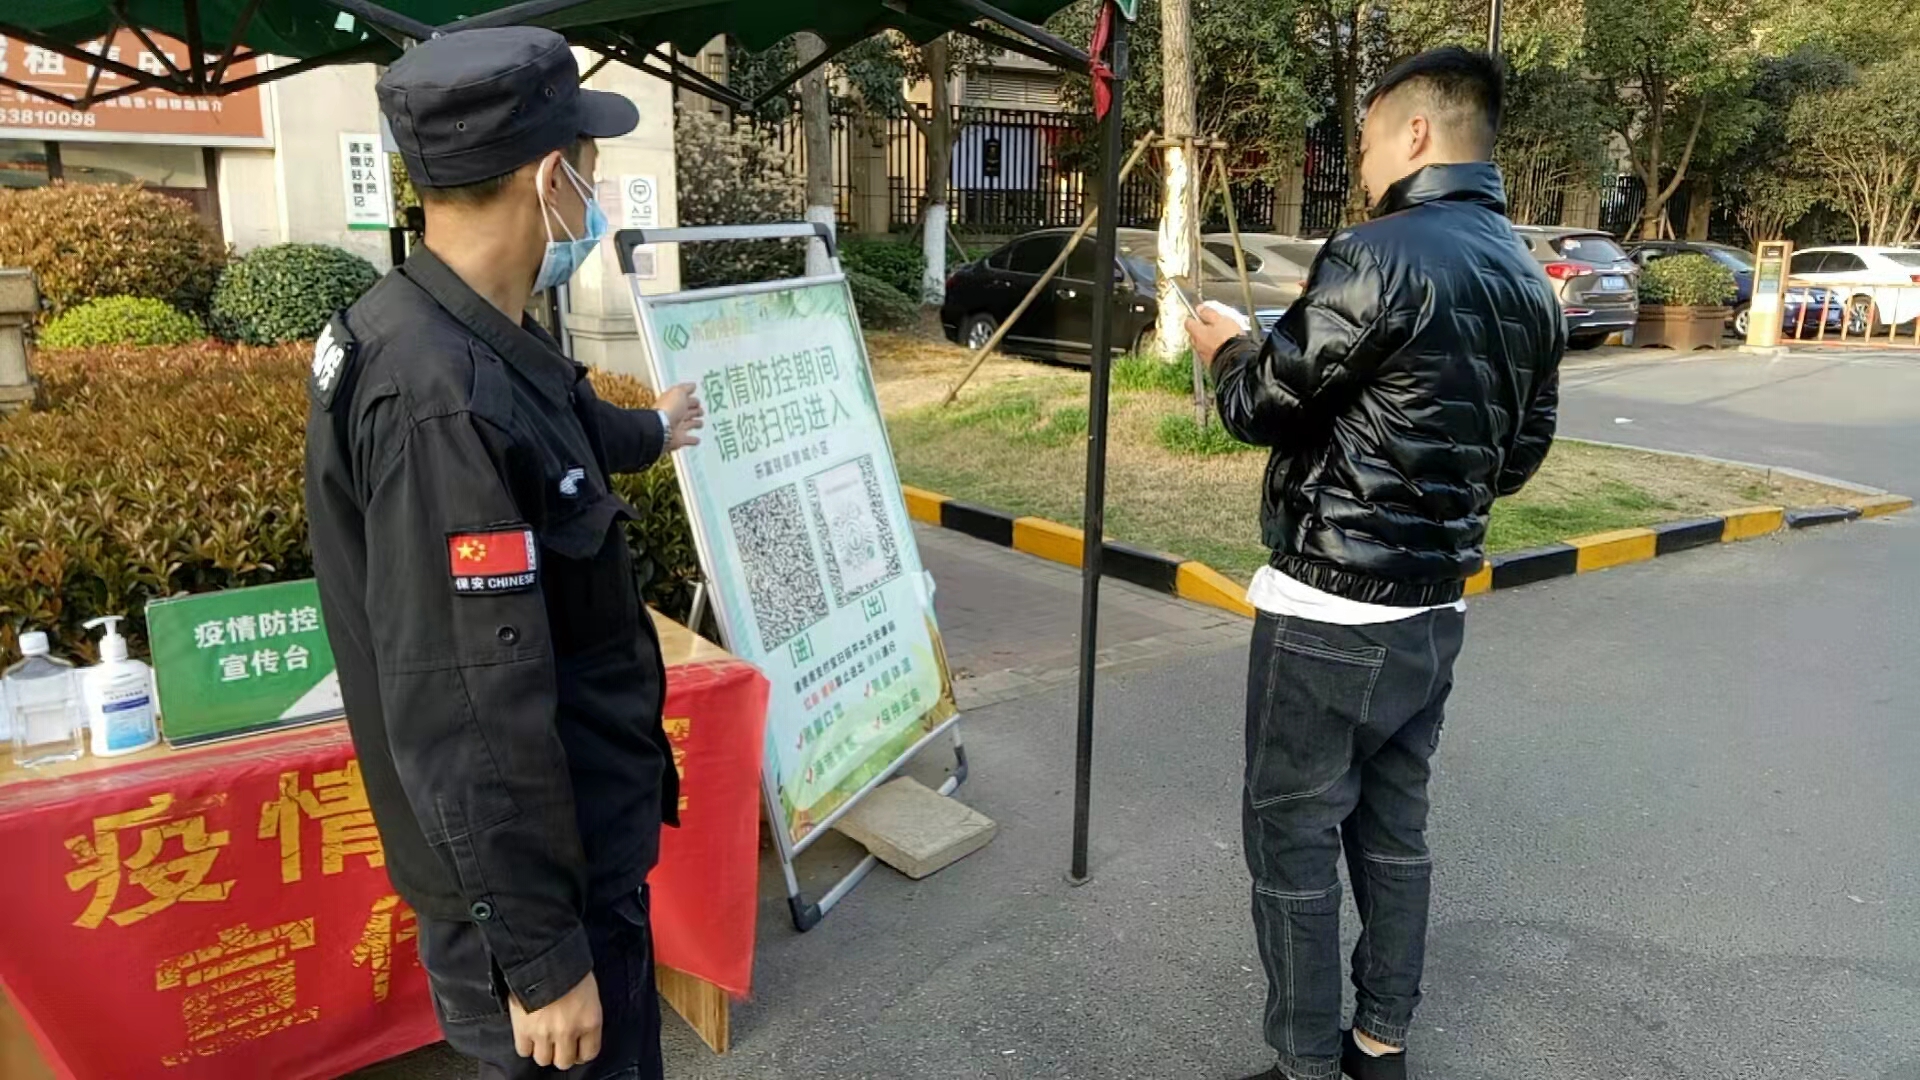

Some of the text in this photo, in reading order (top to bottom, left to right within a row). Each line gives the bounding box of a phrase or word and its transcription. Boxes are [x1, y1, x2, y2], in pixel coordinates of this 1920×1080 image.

[631, 205, 652, 214] 入口
[702, 345, 840, 415] 疫情防控期间
[712, 390, 851, 464] 请您扫码进入
[456, 573, 535, 590] 保安 CHINESE
[194, 606, 320, 649] 疫情防控
[219, 644, 310, 683] 宣传台
